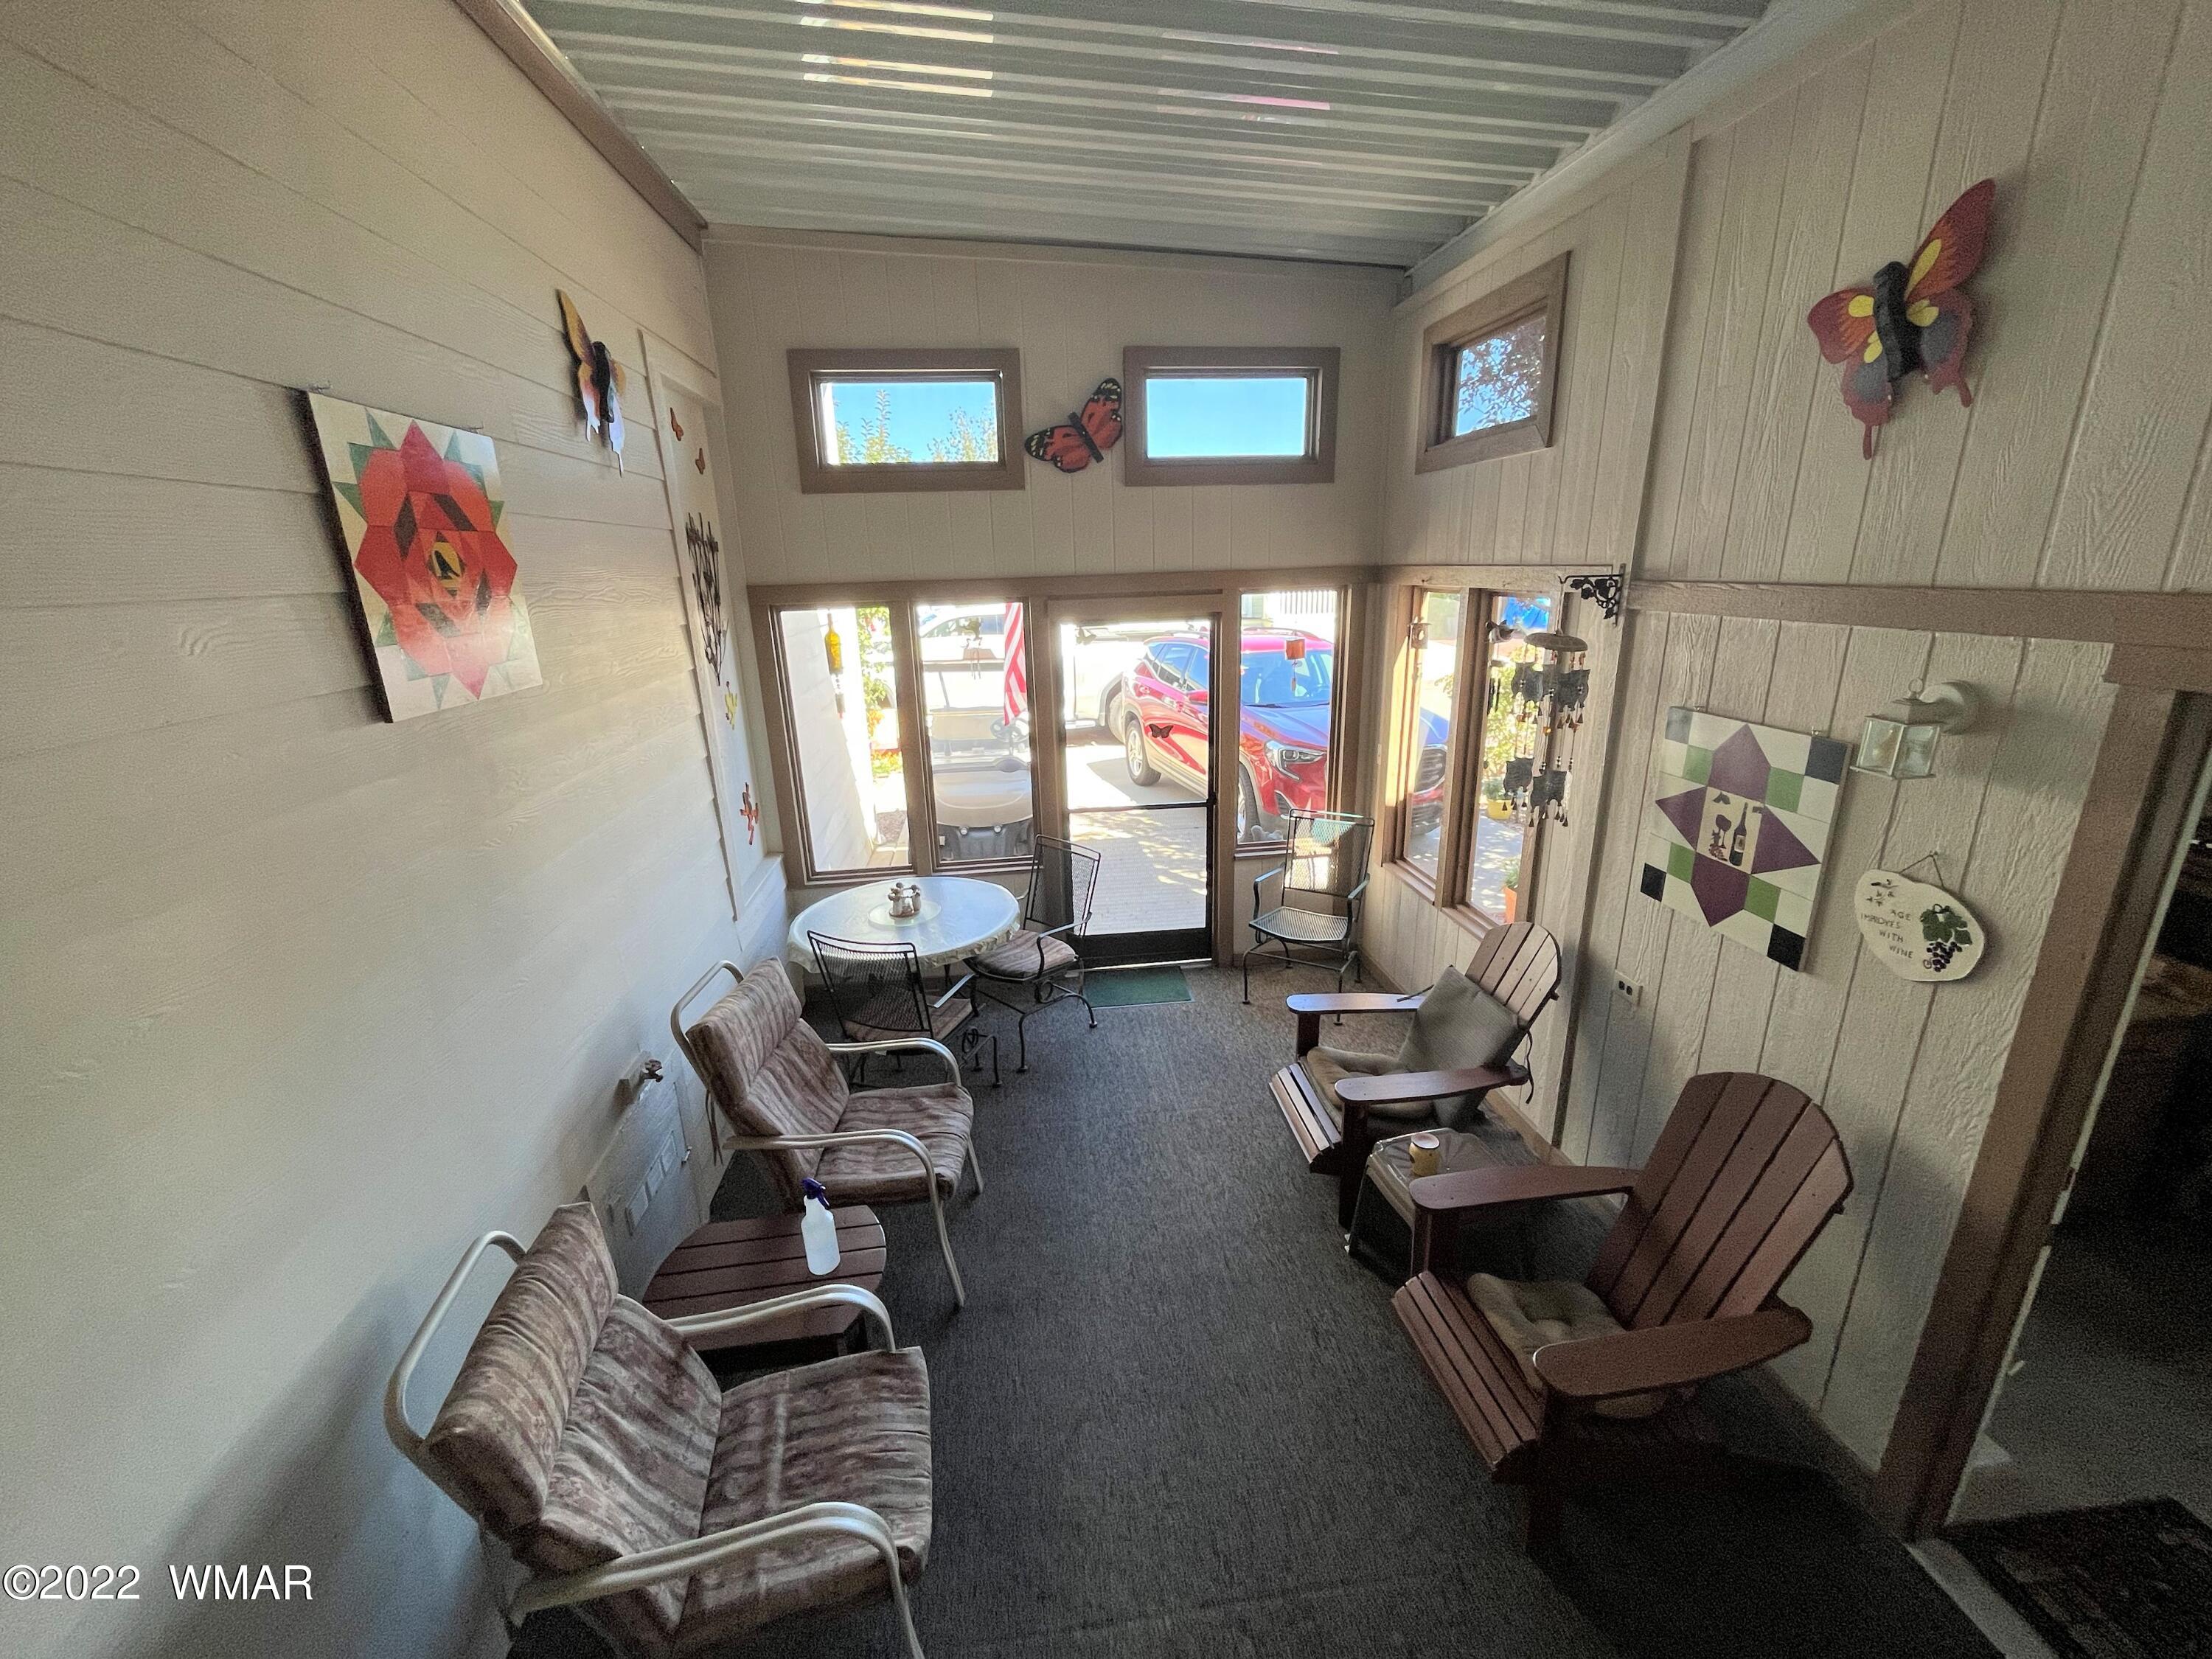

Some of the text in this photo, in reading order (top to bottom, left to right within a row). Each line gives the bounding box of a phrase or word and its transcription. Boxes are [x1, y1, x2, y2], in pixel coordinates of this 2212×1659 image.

[1891, 909, 1911, 921] AGE
[1879, 930, 1904, 942] WITH
[1889, 945, 1913, 959] WINE
